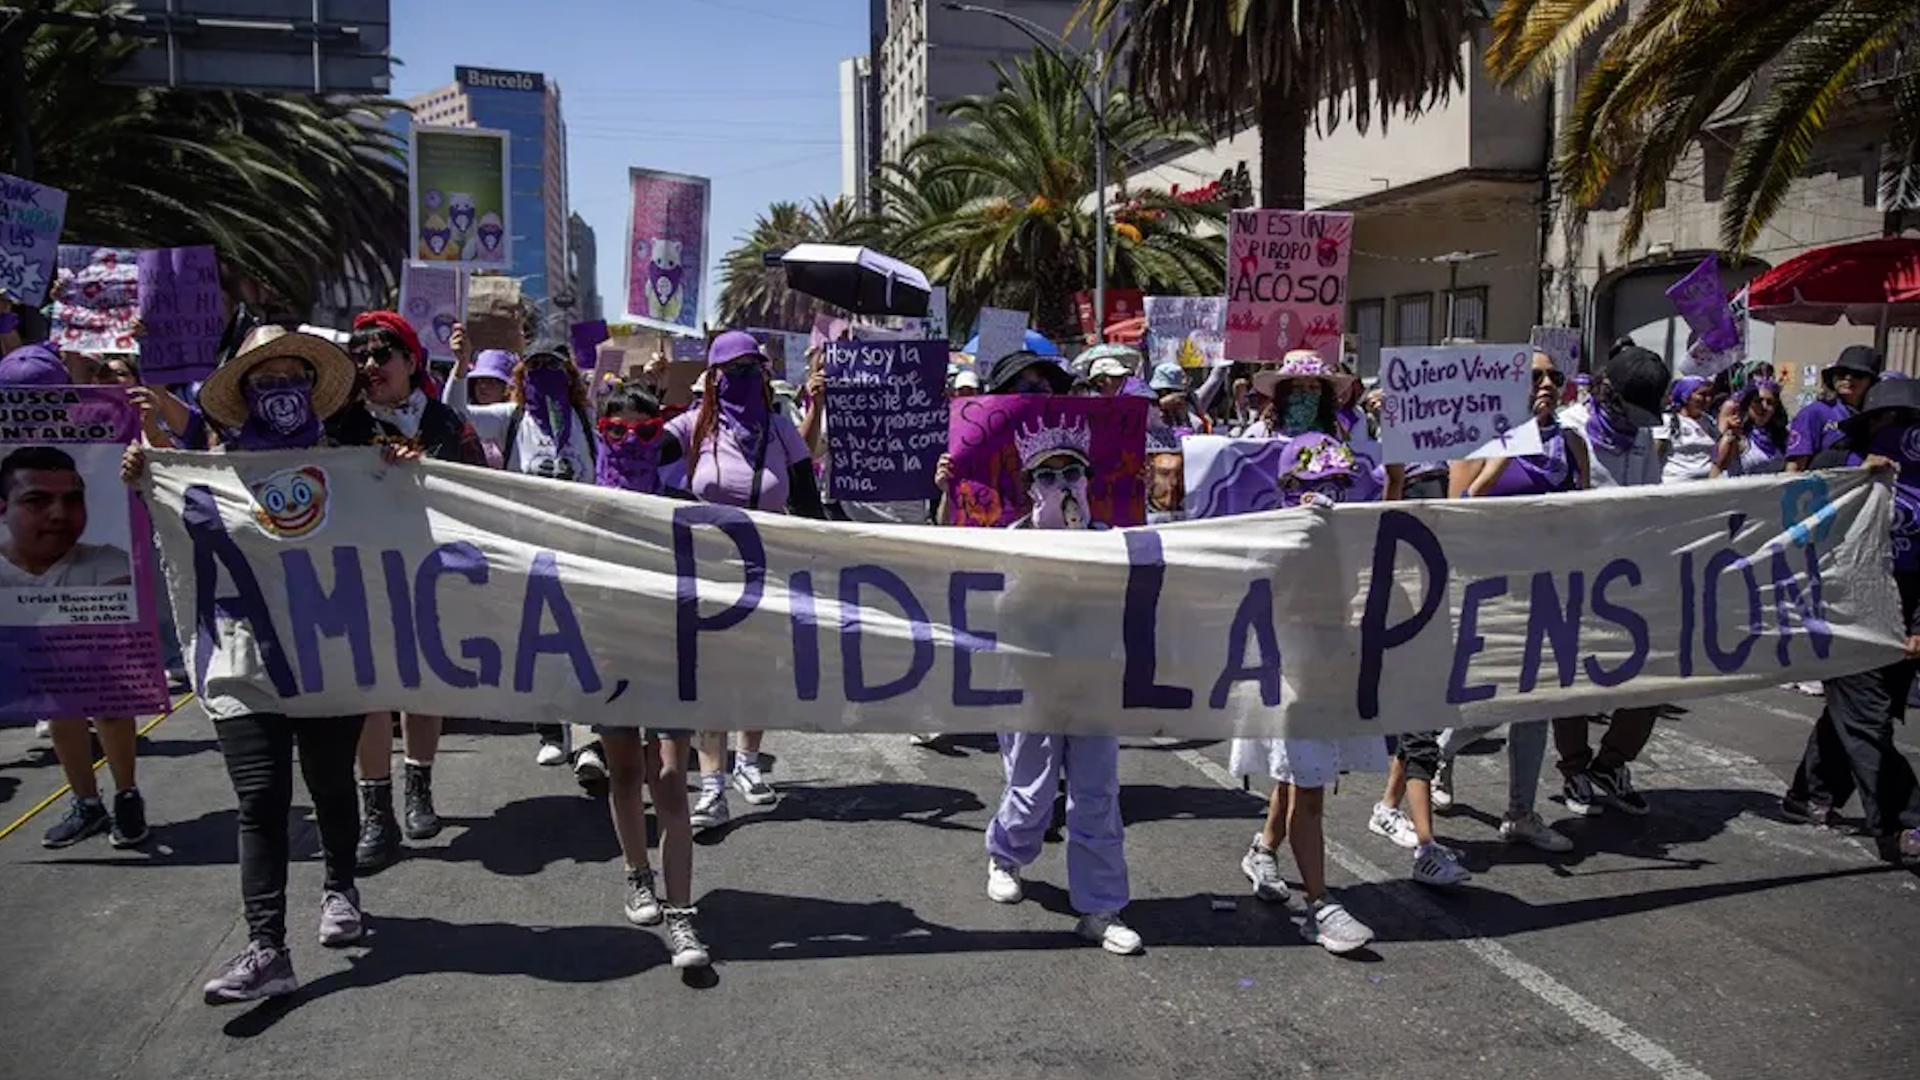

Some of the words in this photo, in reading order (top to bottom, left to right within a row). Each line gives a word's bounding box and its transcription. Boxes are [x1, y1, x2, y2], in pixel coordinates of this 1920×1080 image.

[468, 70, 533, 90] Barceló
[1236, 213, 1258, 235] NO
[1267, 214, 1291, 236] ES
[1249, 241, 1311, 262] PIROPO
[826, 343, 857, 369] Hoy
[900, 343, 921, 364] la
[887, 370, 922, 396] que
[1388, 356, 1458, 392] Quiero
[1461, 355, 1510, 382] Vivir
[907, 386, 934, 407] de
[828, 411, 867, 428] niña
[873, 414, 884, 435] y
[830, 436, 844, 448] a
[1412, 422, 1481, 450] miedo
[902, 452, 923, 472] la
[183, 485, 629, 704] AMIGA,
[672, 504, 1024, 707] PIDE
[1123, 530, 1286, 709] LA
[1356, 508, 1833, 720] PENSIÓN
